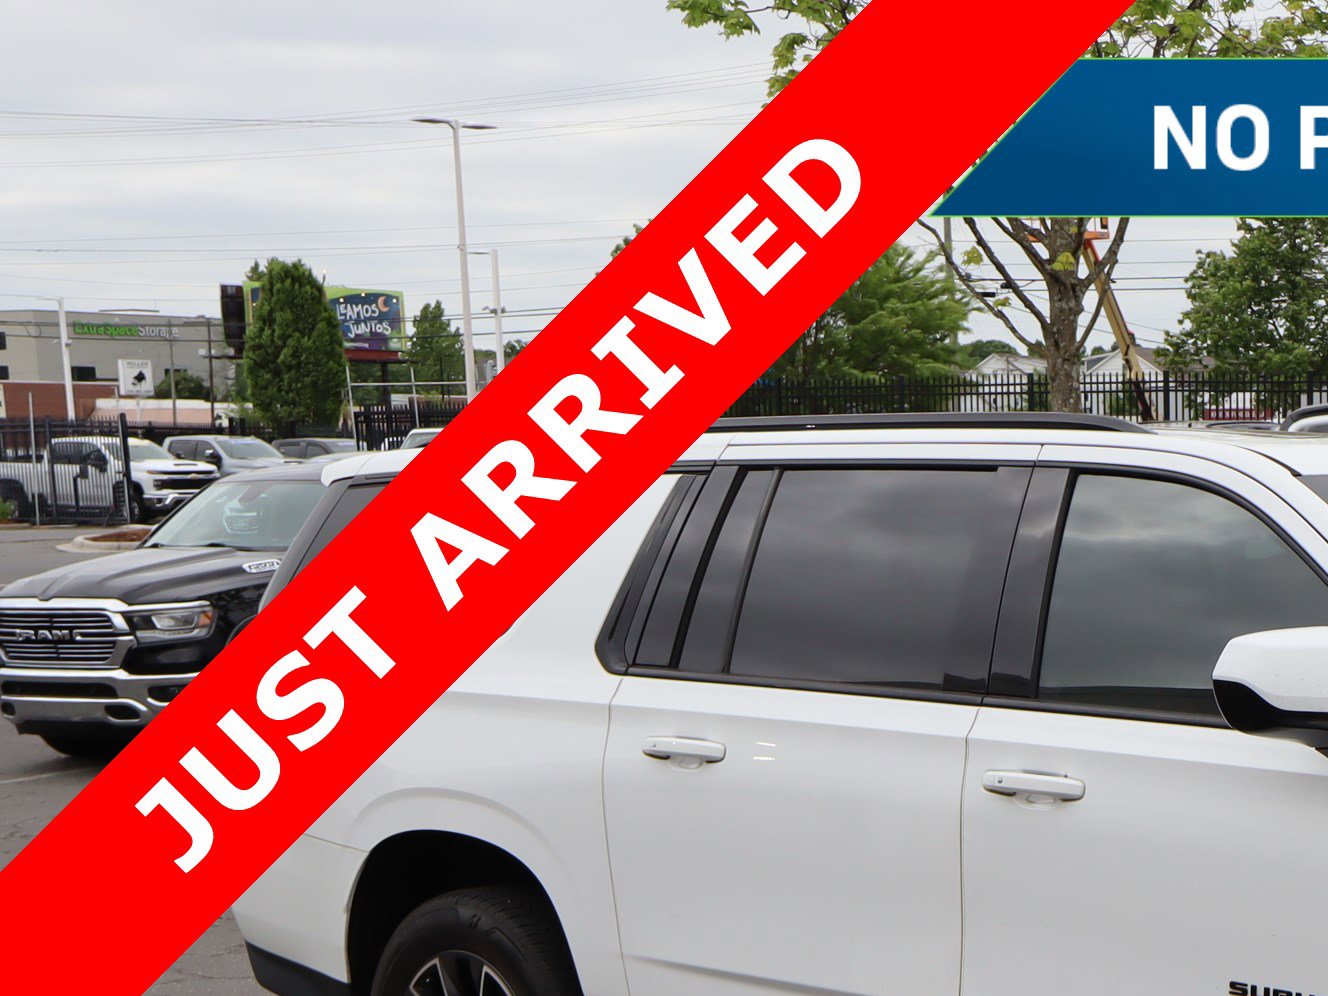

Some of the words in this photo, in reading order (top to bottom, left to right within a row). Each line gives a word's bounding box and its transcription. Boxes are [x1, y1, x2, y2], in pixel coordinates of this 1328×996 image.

[336, 304, 379, 320] LEAMOS
[344, 321, 392, 338] JUNTOS
[17, 629, 70, 641] RAM
